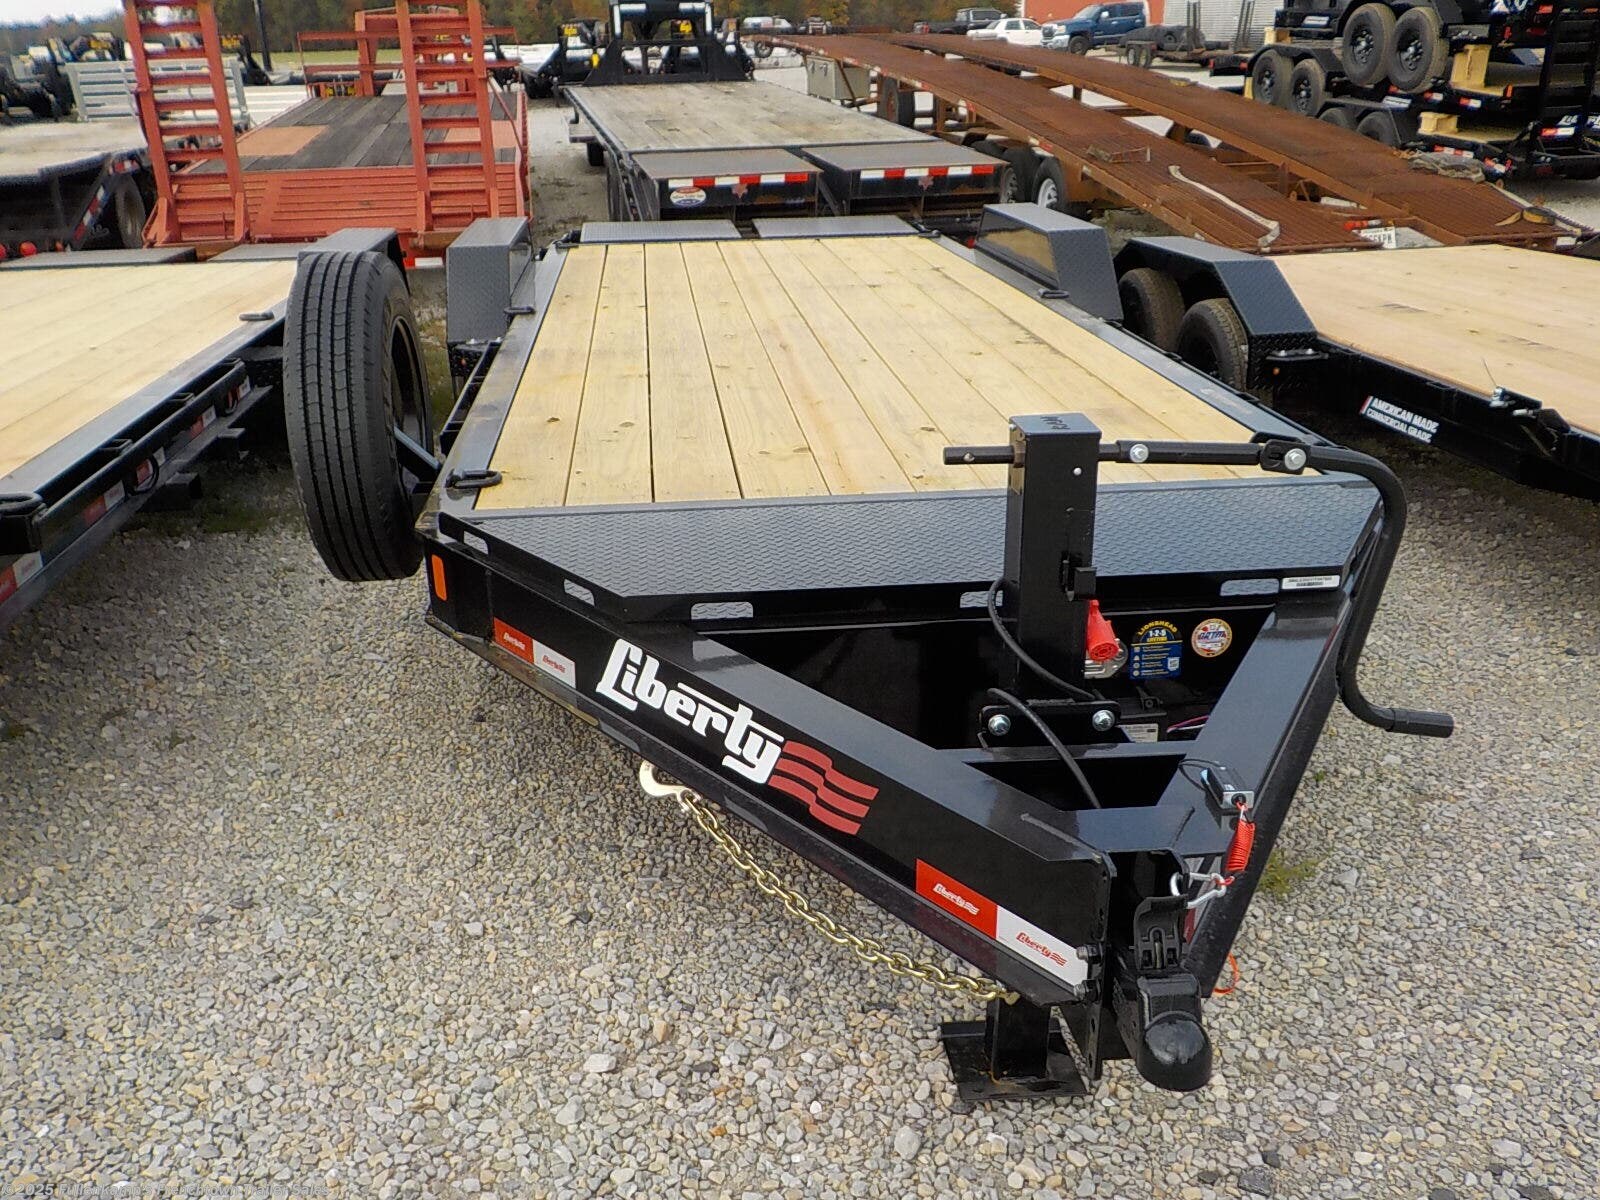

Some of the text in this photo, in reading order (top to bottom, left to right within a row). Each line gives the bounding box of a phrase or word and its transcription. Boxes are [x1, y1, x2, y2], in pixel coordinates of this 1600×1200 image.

[1366, 408, 1432, 444] COMMERCIAL GRADE
[1371, 398, 1439, 434] AMERICAN MADE
[596, 638, 784, 784] Liberty
[933, 883, 966, 908] Liberty
[1016, 932, 1051, 957] Liberty
